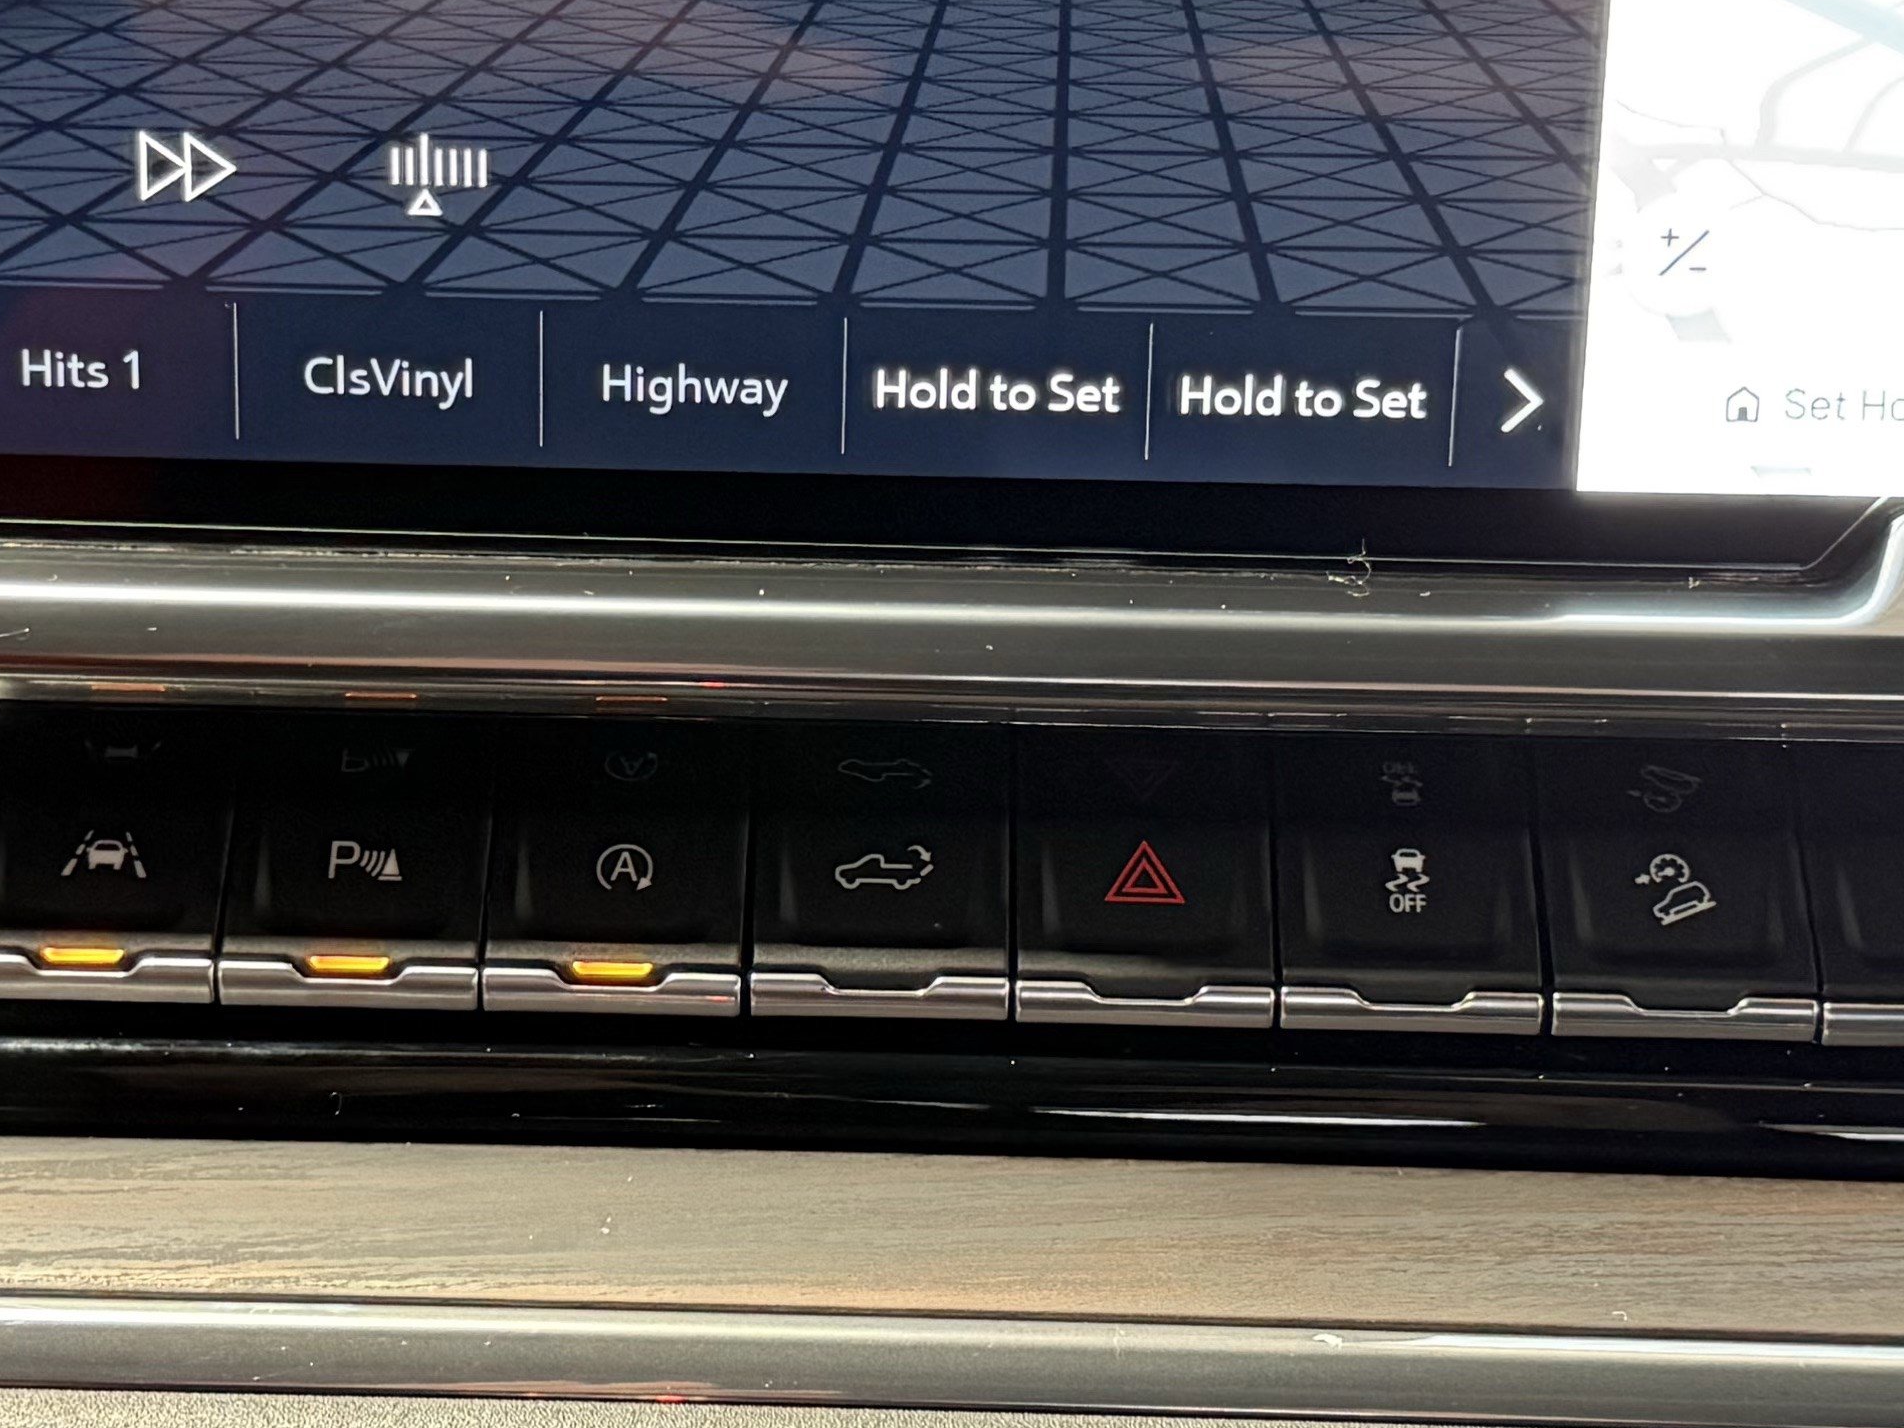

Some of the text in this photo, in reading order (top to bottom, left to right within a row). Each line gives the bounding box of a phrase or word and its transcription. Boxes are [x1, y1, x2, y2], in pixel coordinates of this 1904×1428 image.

[21, 349, 139, 389] Hits 1
[304, 355, 472, 410] ClsVinyl
[603, 363, 788, 417] Highway
[874, 368, 1120, 413] Hold to Set
[1181, 374, 1427, 419] Hold to Set
[1785, 388, 1848, 421] Set
[328, 841, 360, 879] P
[1389, 890, 1427, 913] OFF
